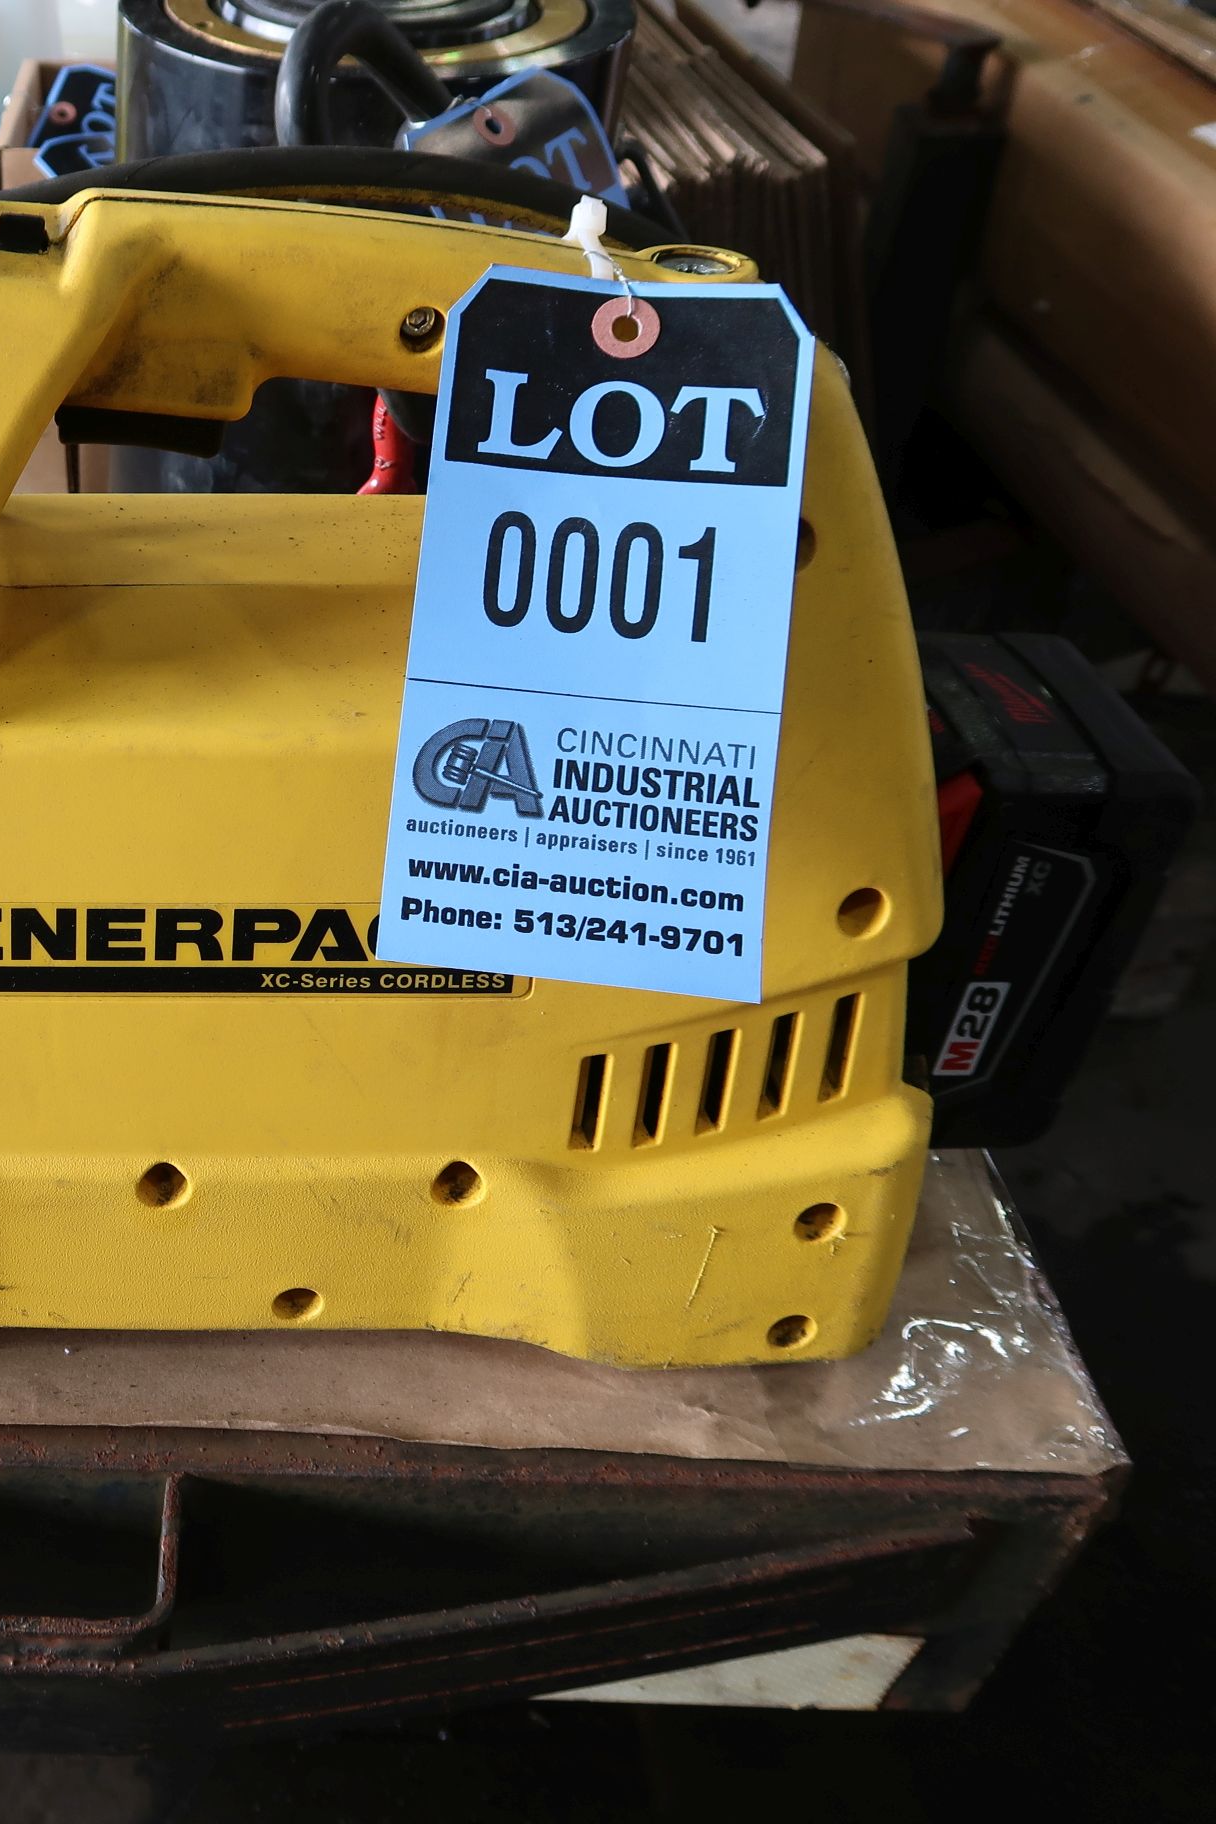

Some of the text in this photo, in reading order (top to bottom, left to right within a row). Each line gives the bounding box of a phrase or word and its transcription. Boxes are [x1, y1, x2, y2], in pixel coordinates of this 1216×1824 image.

[476, 368, 766, 474] LOT
[482, 509, 717, 643] 0001
[555, 726, 758, 770] CINCINNATI
[552, 758, 761, 809] INDUSTRIAL
[405, 816, 756, 868] auctioneers appraisers since 1961
[547, 795, 759, 842] AUCTIONEERS
[407, 858, 745, 913] www.cia-auction.com
[400, 896, 744, 957] Phone: 513/241-9701
[260, 973, 507, 990] XC-Series CORDLESS
[941, 983, 1001, 1072] M28
